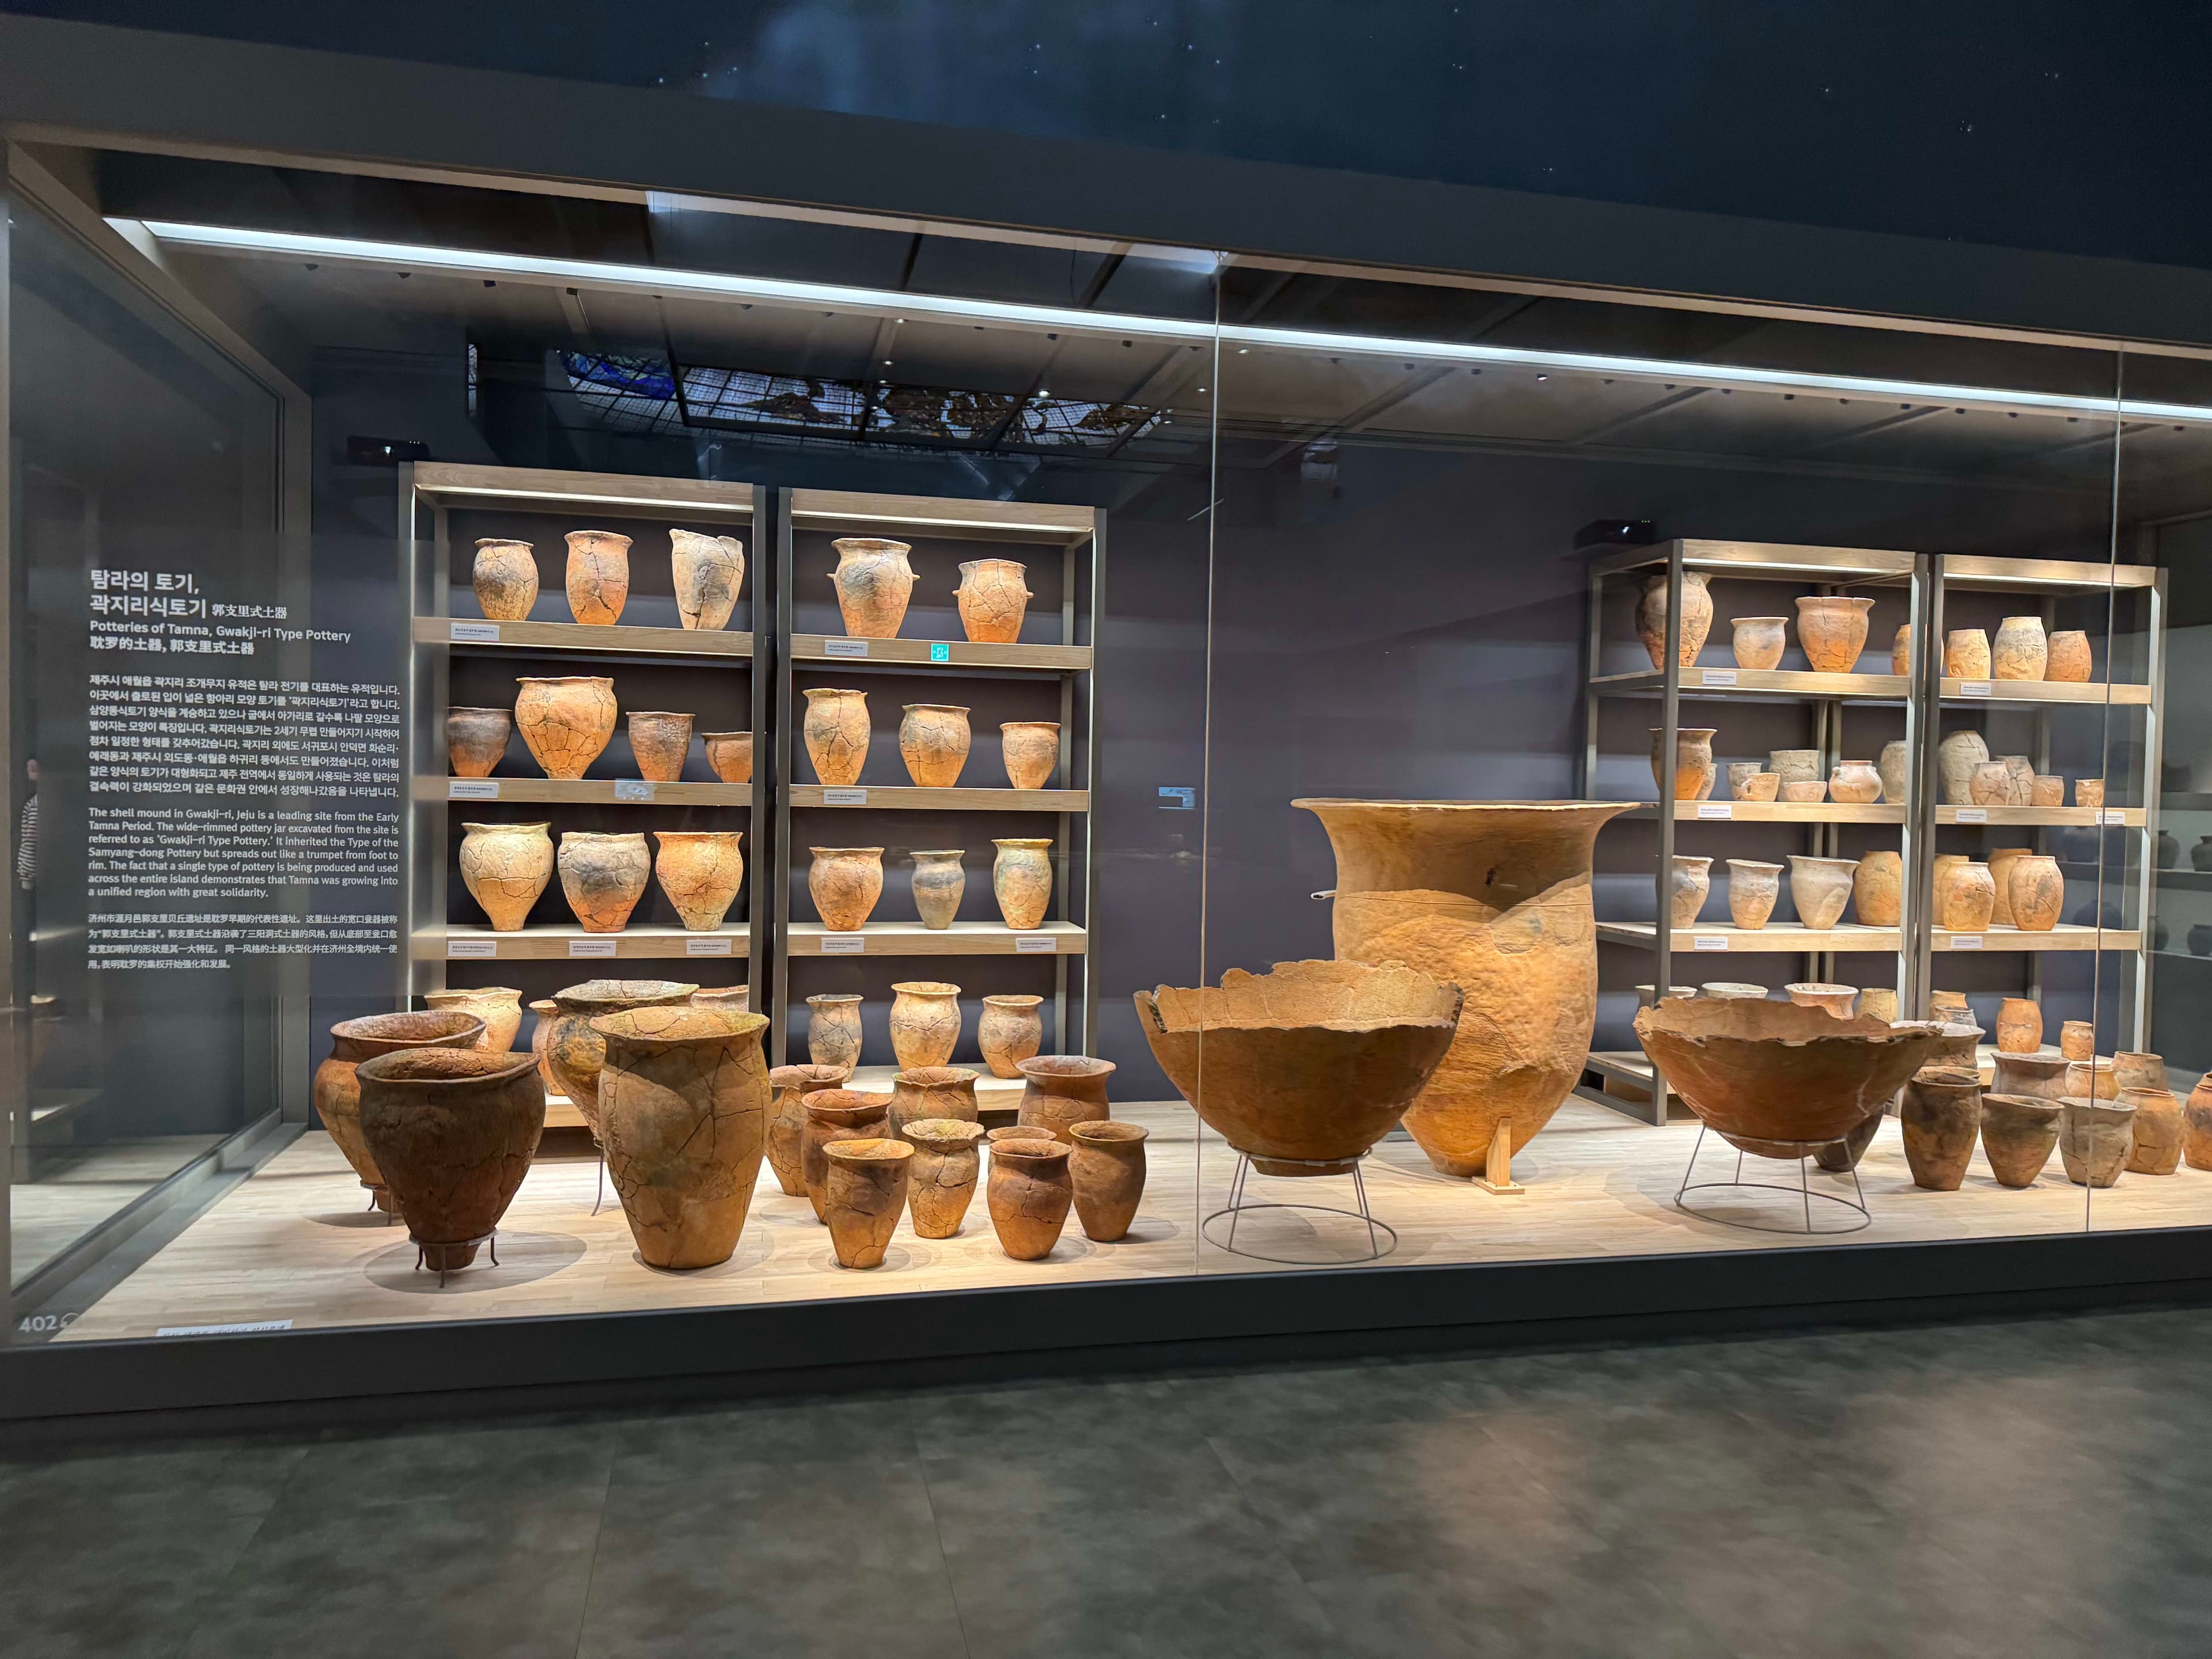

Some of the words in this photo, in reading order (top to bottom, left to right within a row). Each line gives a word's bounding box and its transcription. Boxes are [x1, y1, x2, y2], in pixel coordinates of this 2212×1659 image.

[91, 570, 147, 590] 탐라의
[154, 574, 199, 593] 토기,
[90, 595, 205, 618] 곽지리식토기
[212, 604, 287, 619] 郭支里式土器
[90, 620, 148, 632] Potteries
[151, 623, 165, 634] of
[167, 624, 212, 637] Tamna,
[274, 628, 302, 641] Type
[306, 630, 351, 643] Pottery
[90, 636, 166, 652] 耽罗的土器,
[170, 639, 254, 654] 郭支里式土器
[90, 675, 119, 685] 제주시
[122, 676, 152, 686] 애월읍
[154, 677, 183, 687] 곽지리
[185, 678, 225, 688] 조개무지
[227, 679, 256, 690] 유적은
[259, 680, 278, 690] 탐라
[280, 681, 309, 692] 전기를
[312, 683, 349, 693] 대표하는
[350, 684, 400, 695] 유적입니다.
[89, 690, 128, 700] 이곳에서
[162, 692, 181, 702] 입이
[206, 694, 234, 704] 항아리
[236, 695, 256, 705] 모양
[257, 696, 286, 706] 토기를
[370, 699, 400, 709] 합니다.
[89, 705, 146, 716] 삼양동식토기
[148, 707, 176, 717] 양식을
[179, 708, 216, 718] 계승하고
[218, 709, 246, 719] 있으나
[278, 711, 313, 721] 아가리로
[345, 713, 363, 723] 나팔
[364, 714, 400, 724] 모양으로
[90, 721, 127, 731] 벌어지는
[128, 722, 156, 732] 모양이
[209, 724, 272, 735] 곽지리식토기는
[274, 726, 297, 736] 2세기
[300, 726, 317, 736] 무렵
[319, 727, 362, 737] 만들어지기
[365, 729, 399, 738] 시작하여
[89, 736, 109, 745] 점차
[111, 736, 139, 747] 일정한
[173, 738, 240, 749] 갖추어갔습니다.
[242, 740, 269, 750] 곽지리
[272, 740, 300, 750] 외에도
[301, 741, 337, 752] 서귀포시
[340, 743, 366, 752] 안덕면
[131, 752, 161, 762] 제주시
[229, 754, 257, 764] 하귀리
[260, 755, 299, 765] 등에서도
[301, 756, 369, 767] 만들어졌습니다.
[372, 758, 399, 768] 이처럼
[90, 766, 108, 776] 같은
[110, 766, 138, 777] 양식의
[141, 767, 169, 777] 토기가
[171, 768, 217, 778] 대형화되고
[219, 769, 237, 779] 제주
[239, 770, 275, 779] 전역에서
[278, 770, 313, 781] 동일하게
[315, 771, 351, 781] 사용되는
[353, 772, 371, 782] 것은
[373, 772, 399, 782] 탐라의
[132, 782, 191, 793] 강화되었으며
[195, 783, 214, 793] 같은
[217, 784, 245, 794] 문화권
[248, 785, 276, 794] 안에서
[280, 785, 347, 796] 성장해나갔음을
[350, 787, 399, 797] 나타냅니다.
[89, 808, 107, 816] The
[109, 808, 134, 817] shell
[137, 809, 171, 817] mound
[174, 809, 183, 817] in
[236, 810, 255, 820] Jeju
[258, 810, 266, 819] is
[277, 811, 312, 821] leading
[315, 812, 331, 820] site
[334, 812, 355, 820] from
[358, 812, 373, 821] the
[377, 813, 399, 823] Early
[89, 821, 119, 830] Tamna
[122, 821, 154, 830] Period.
[157, 822, 173, 831] The
[240, 824, 272, 834] pottery
[274, 823, 286, 834] jar
[288, 825, 331, 833] excavated
[335, 824, 354, 833] from
[357, 825, 370, 834] the
[373, 825, 389, 834] site
[392, 825, 399, 834] is
[89, 834, 127, 843] referred
[130, 835, 140, 843] to
[207, 836, 230, 846] Type
[276, 836, 282, 845] It
[285, 836, 327, 846] inherited
[329, 838, 345, 846] the
[347, 838, 369, 848] Type
[372, 838, 381, 846] of
[383, 839, 398, 847] the
[167, 849, 201, 858] Pottery
[203, 849, 219, 857] but
[222, 849, 259, 859] spreads
[279, 849, 296, 858] like
[306, 851, 343, 860] trumpet
[346, 850, 366, 859] from
[369, 850, 387, 859] foot
[389, 851, 398, 859] to
[89, 860, 107, 869] rim.
[109, 861, 127, 869] The
[129, 861, 146, 869] fact
[149, 861, 168, 870] that
[178, 861, 206, 872] single
[208, 862, 228, 872] type
[230, 862, 240, 870] of
[242, 863, 275, 872] pottery
[277, 862, 285, 871] is
[287, 862, 312, 873] being
[315, 863, 355, 873] produced
[358, 863, 374, 872] and
[377, 863, 397, 872] used
[122, 874, 137, 882] the
[139, 874, 167, 883] entire
[170, 874, 198, 883] island
[201, 875, 265, 884] demonstrates
[267, 876, 286, 884] that
[288, 876, 319, 884] Tamna
[342, 876, 378, 886] growing
[381, 876, 397, 885] into
[97, 887, 131, 896] unified
[135, 887, 165, 897] region
[168, 887, 190, 896] with
[192, 888, 218, 897] great
[220, 888, 268, 897] solidarity.
[18, 1315, 58, 1332] 402
